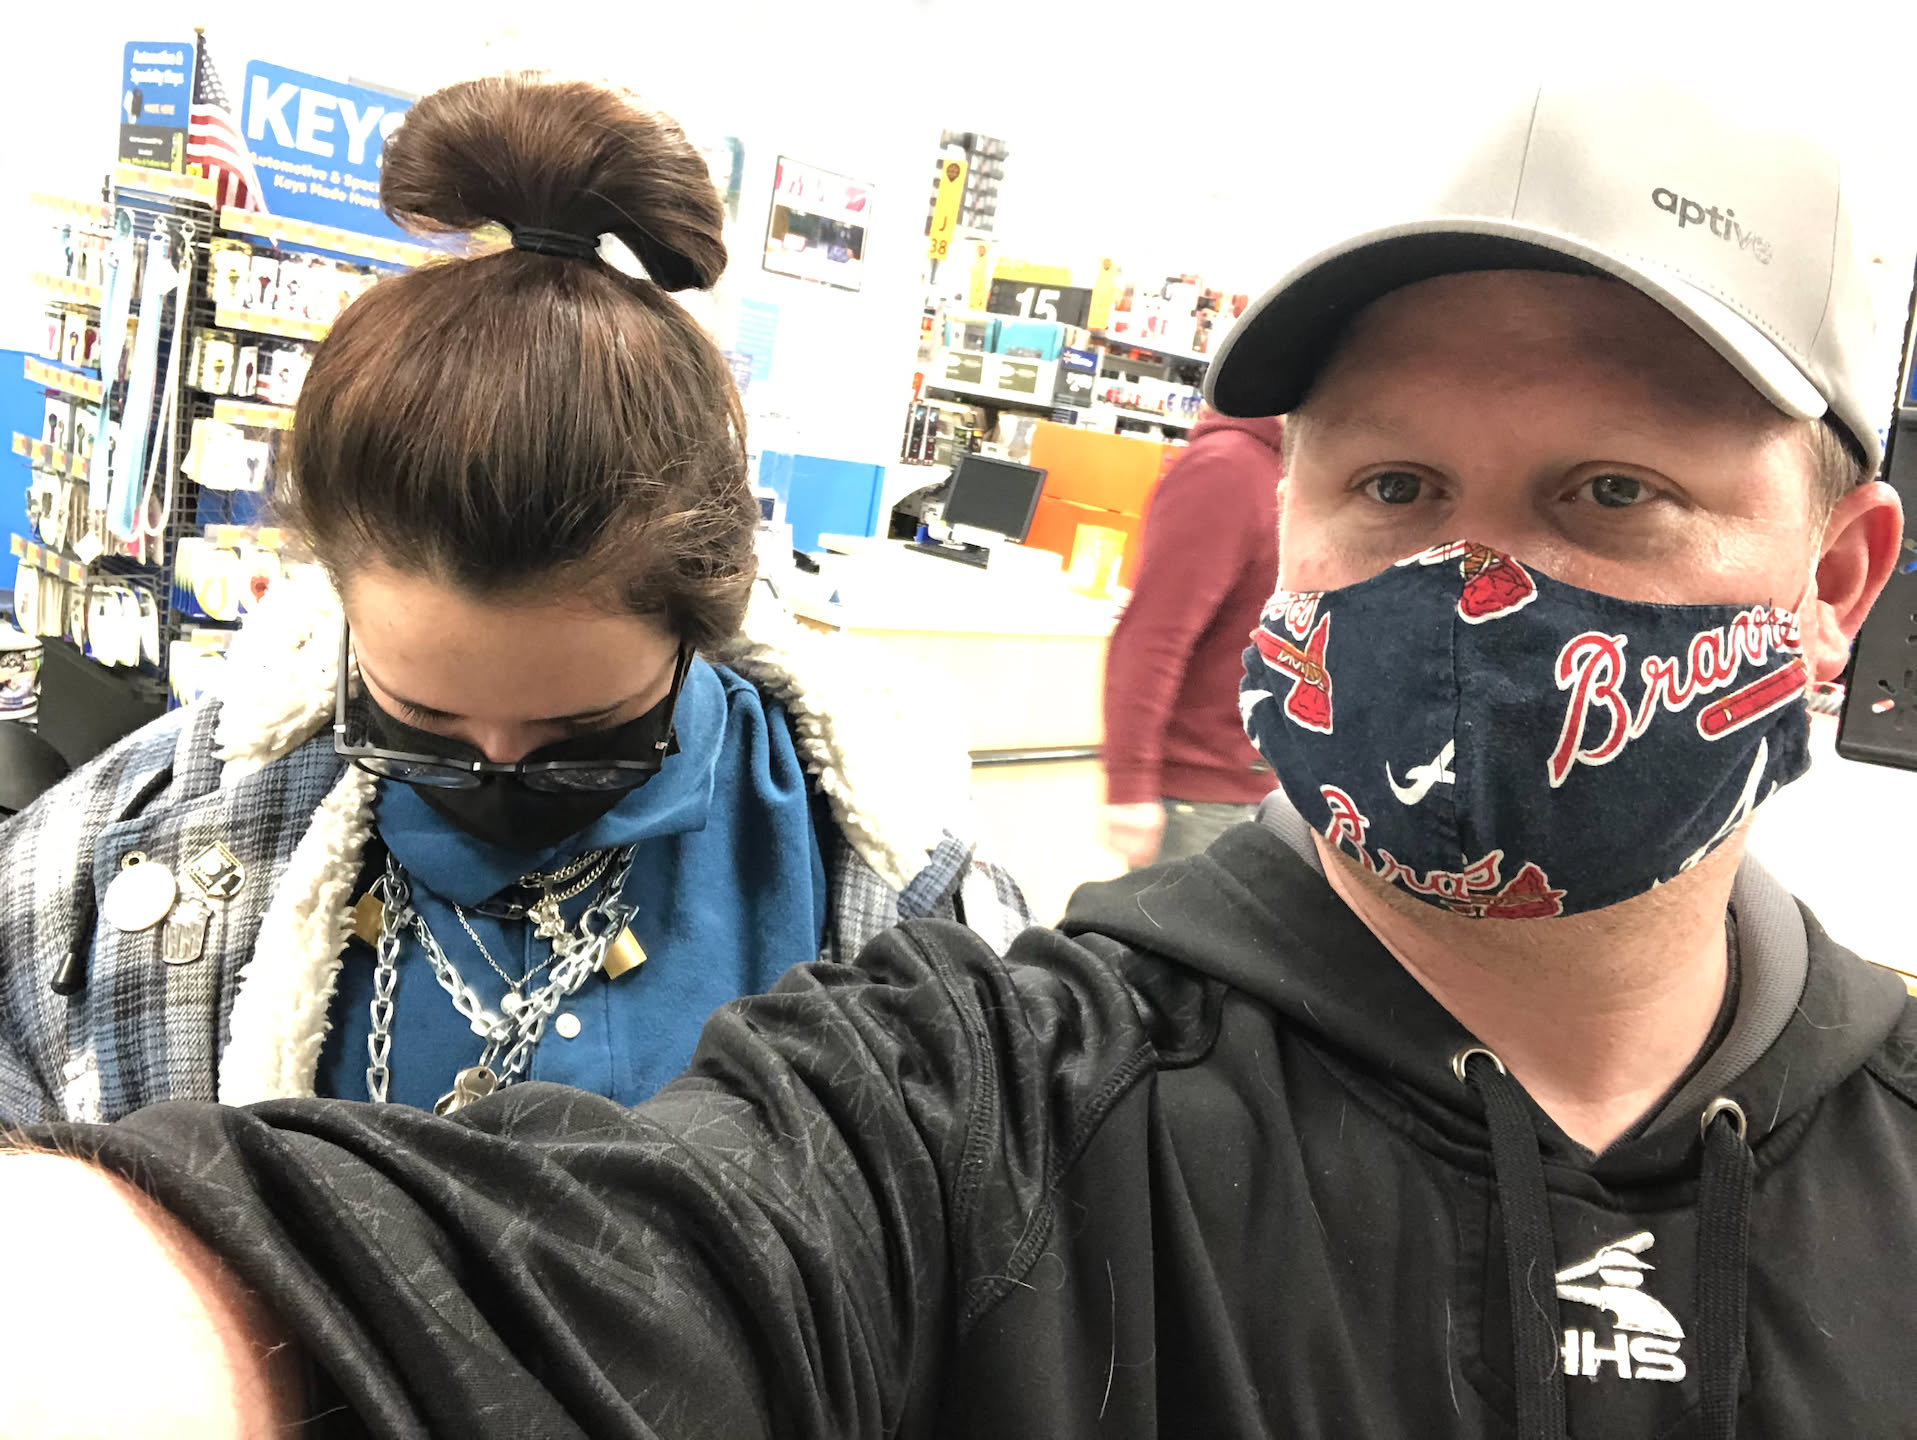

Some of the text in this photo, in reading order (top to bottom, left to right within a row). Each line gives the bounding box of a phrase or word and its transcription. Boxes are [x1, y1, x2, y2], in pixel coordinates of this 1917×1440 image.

[274, 174, 307, 193] Keys
[310, 182, 347, 202] Made
[938, 215, 948, 232] J
[929, 238, 948, 255] 38
[1015, 286, 1061, 321] 15
